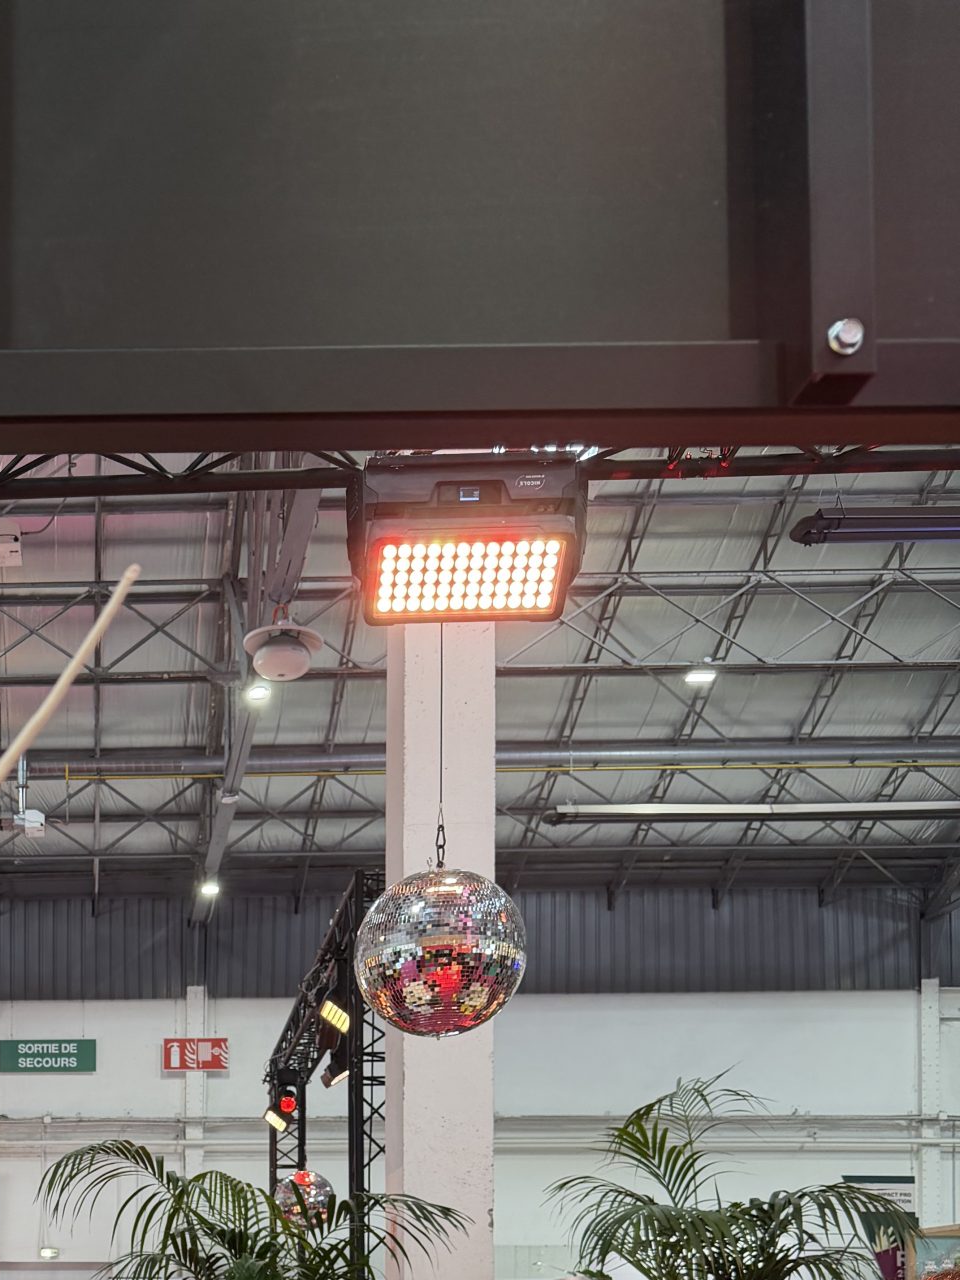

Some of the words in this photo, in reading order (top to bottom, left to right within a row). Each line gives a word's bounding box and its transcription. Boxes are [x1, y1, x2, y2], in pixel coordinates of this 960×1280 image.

[18, 1043, 59, 1054] SORTIE
[61, 1043, 77, 1053] DE
[18, 1057, 77, 1068] SECOURS
